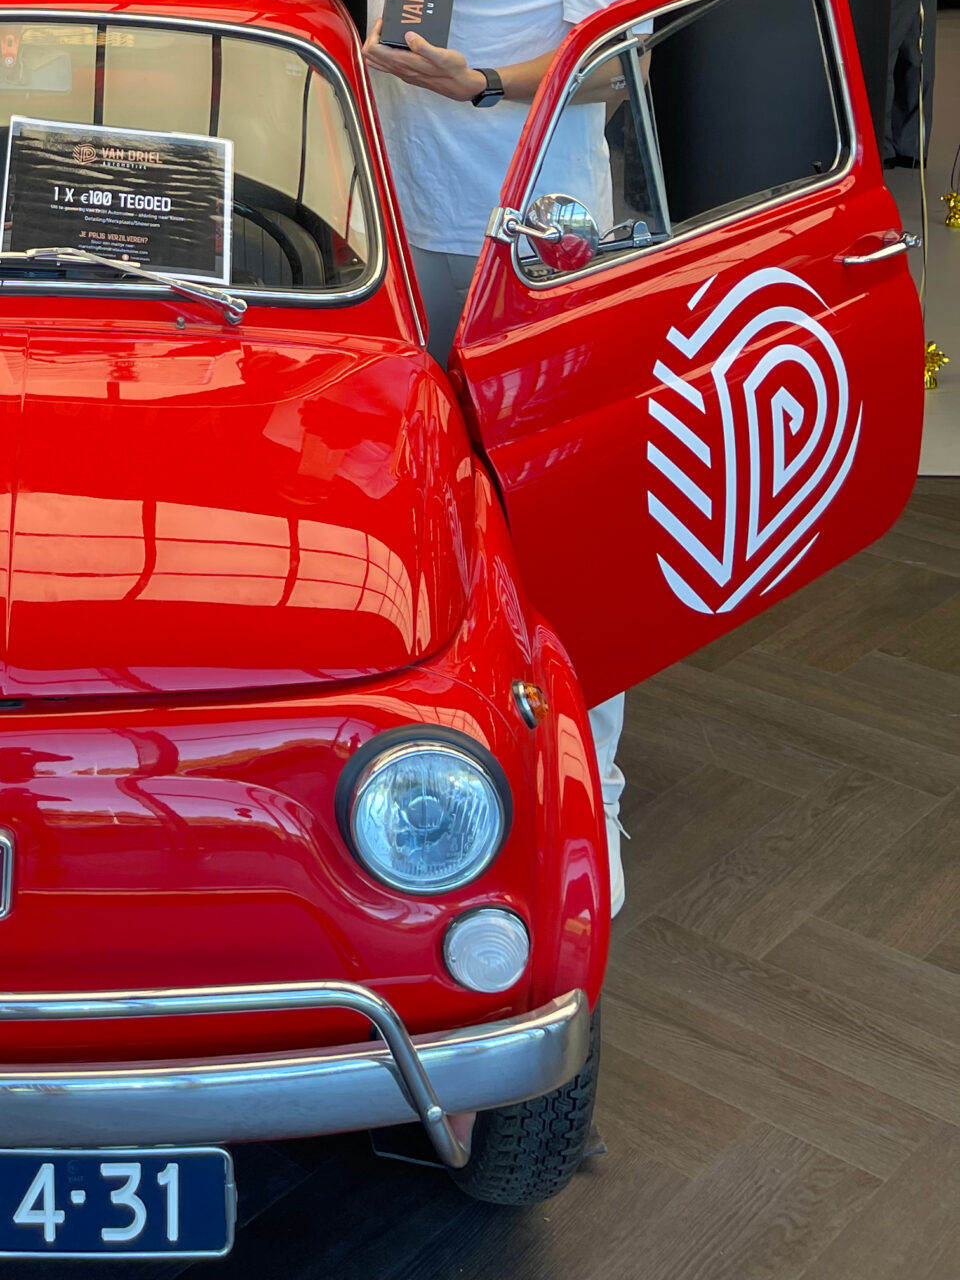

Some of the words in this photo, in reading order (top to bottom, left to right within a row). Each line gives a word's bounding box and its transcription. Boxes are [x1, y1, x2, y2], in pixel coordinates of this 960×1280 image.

[102, 147, 124, 161] VAN
[127, 149, 163, 164] DRIEL
[54, 187, 59, 201] 1
[64, 188, 74, 203] X
[80, 190, 112, 206] €100
[118, 193, 171, 212] TEGOED
